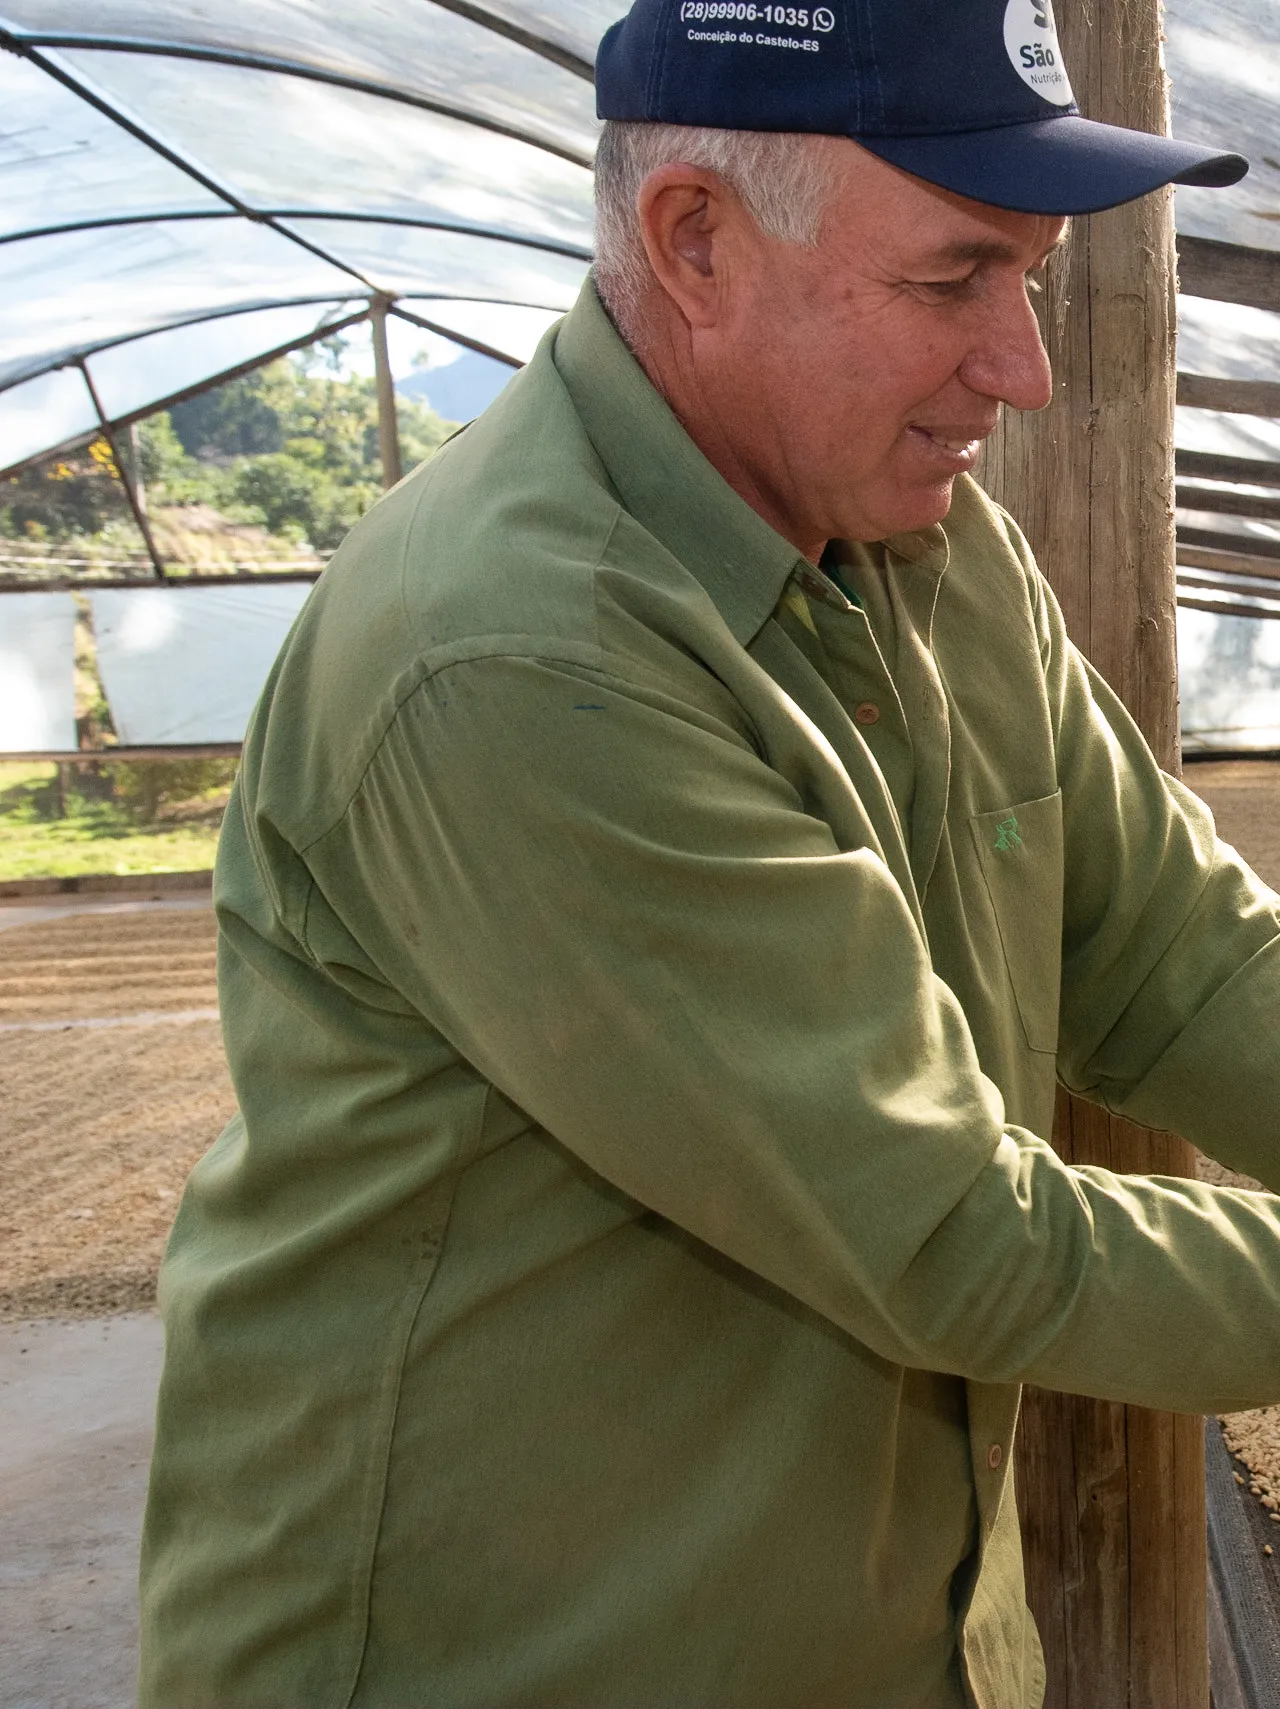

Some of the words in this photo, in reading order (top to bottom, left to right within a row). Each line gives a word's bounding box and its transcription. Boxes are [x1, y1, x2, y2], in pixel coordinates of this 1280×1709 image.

[680, 1, 809, 27] (28)99906-1035
[687, 29, 737, 44] Conceição
[739, 32, 753, 43] do
[755, 34, 820, 52] Castelo-ES
[1019, 43, 1055, 69] São
[1030, 72, 1062, 85] Nutrição
